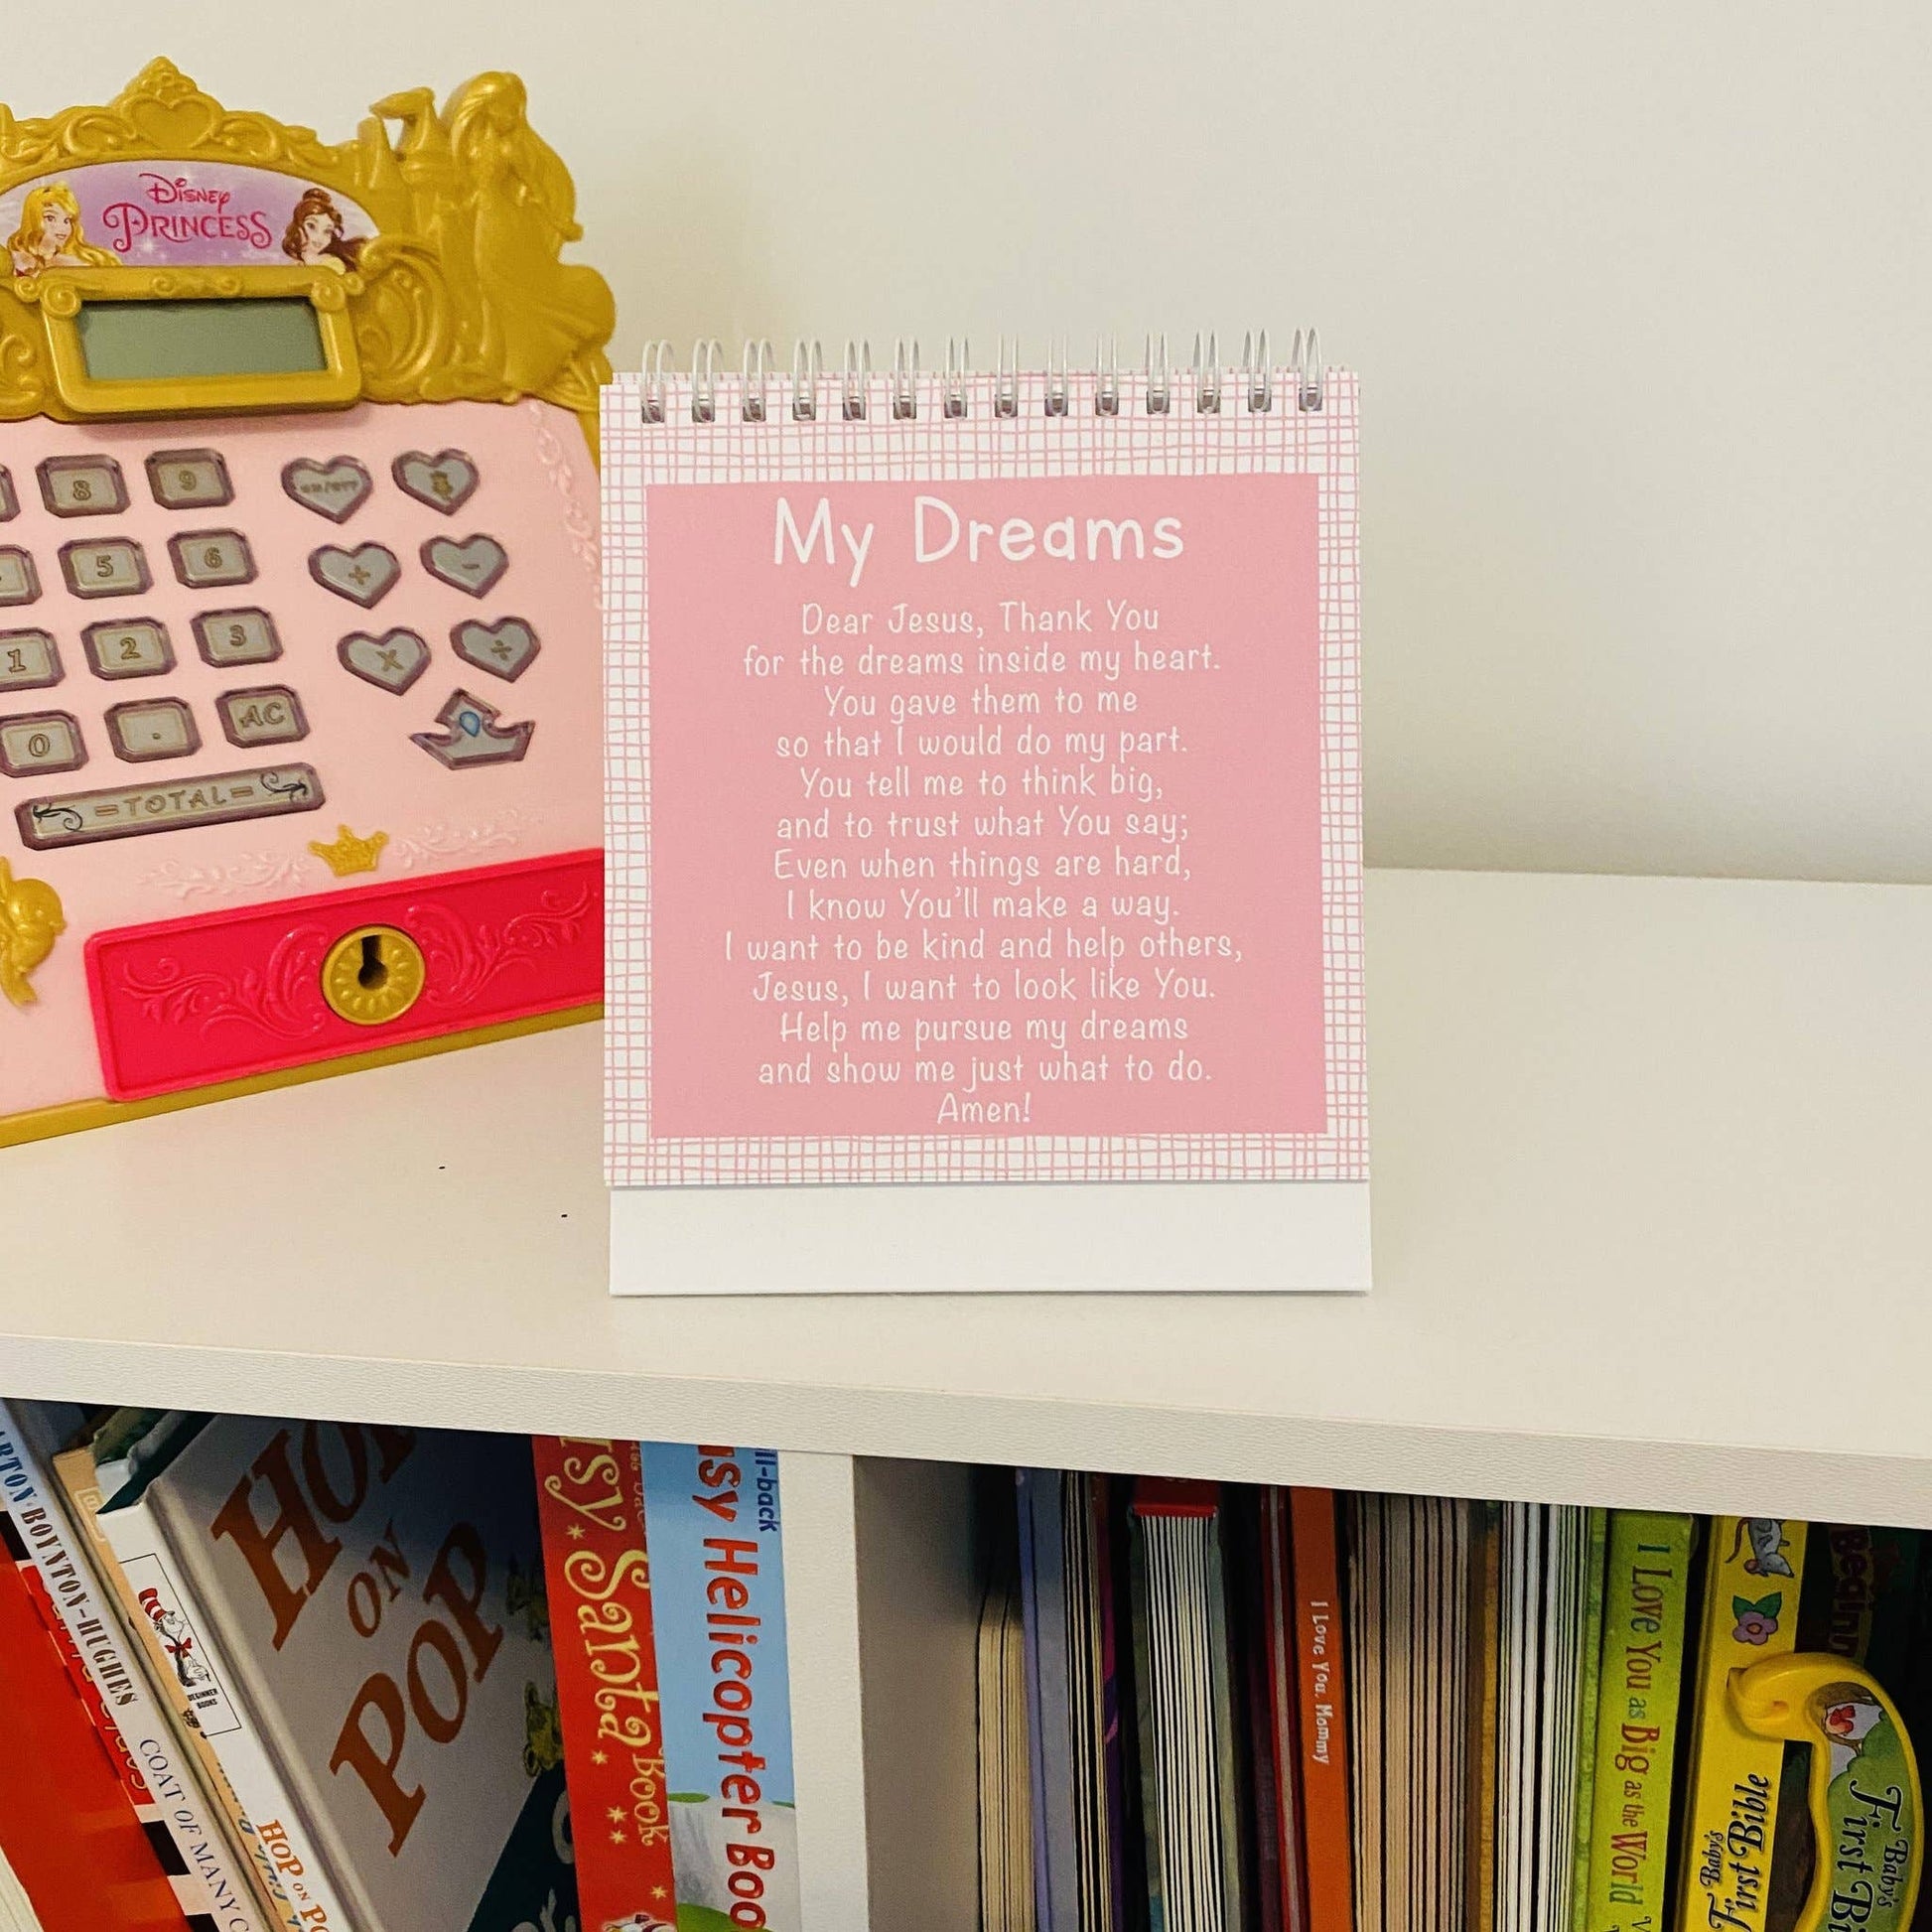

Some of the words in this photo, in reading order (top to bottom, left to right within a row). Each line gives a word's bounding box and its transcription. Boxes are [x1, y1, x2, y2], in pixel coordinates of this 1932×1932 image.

[102, 201, 273, 253] PRINCESS
[71, 479, 92, 501] 8
[179, 470, 196, 492] 9
[94, 554, 114, 578] 5
[204, 547, 223, 570] 6
[773, 496, 875, 589] My
[914, 495, 1184, 564] Dreams
[802, 603, 874, 635] Dear
[888, 603, 984, 639] Jesus,
[998, 599, 1093, 633] Thank
[1106, 599, 1159, 631] You
[7, 647, 27, 673] 1
[119, 635, 142, 660] 2
[228, 624, 248, 647] 3
[743, 644, 784, 677] for
[799, 643, 844, 676] the
[858, 643, 964, 676] dreams
[978, 640, 1066, 674] inside
[1080, 650, 1121, 682] my
[1134, 639, 1220, 671] heart.
[29, 733, 52, 758] 0
[238, 701, 287, 729] AC
[824, 685, 876, 718] You
[890, 694, 957, 726] gave
[970, 683, 1040, 715] them
[1054, 686, 1083, 714] to
[1097, 690, 1138, 713] me
[775, 736, 809, 759] so
[823, 726, 882, 758] that
[897, 725, 903, 756] I
[918, 723, 1002, 757] would
[1017, 723, 1051, 756] do
[1065, 732, 1105, 763] my
[1120, 726, 1187, 764] part.
[799, 766, 852, 799] You
[866, 764, 909, 797] tell
[923, 774, 964, 796] me
[978, 769, 1007, 796] to
[1021, 762, 1097, 796] think
[1110, 762, 1163, 803] big,
[776, 807, 830, 840] and
[844, 811, 874, 839] to
[887, 810, 960, 838] trust
[974, 805, 1044, 837] what
[1058, 804, 1111, 837] You
[1125, 813, 1188, 844] say;
[774, 848, 847, 880] Even
[861, 847, 935, 879] when
[948, 846, 1040, 887] things
[1054, 855, 1101, 878] are
[1115, 843, 1190, 882] hard,
[787, 889, 794, 920] I
[809, 888, 886, 921] know
[993, 886, 1067, 919] make
[1081, 896, 1097, 918] a
[1111, 895, 1179, 926] way.
[726, 930, 732, 961] I
[747, 934, 819, 962] want
[833, 933, 862, 961] to
[877, 929, 908, 961] be
[922, 927, 985, 962] kind
[999, 926, 1052, 960] and
[1066, 925, 1126, 968] help
[1140, 925, 1242, 963] others,
[753, 971, 849, 1008] Jesus,
[864, 970, 871, 1001] I
[886, 973, 957, 1002] want
[972, 973, 1001, 1001] to
[1015, 967, 1077, 1001] look
[1090, 967, 1141, 1001] like
[1154, 966, 1215, 1000] You.
[779, 1010, 847, 1053] Help
[861, 1020, 901, 1042] me
[915, 1018, 1013, 1052] pursue
[1026, 1019, 1066, 1050] my
[1080, 1008, 1188, 1041] dreams
[758, 1051, 811, 1085] and
[826, 1051, 901, 1084] show
[915, 1060, 955, 1083] me
[962, 1055, 1025, 1094] just
[1038, 1049, 1109, 1082] what
[1124, 1053, 1155, 1081] to
[1168, 1048, 1212, 1081] do.
[936, 1091, 1032, 1125] Amen!
[0, 1431, 38, 1503] RTON
[544, 1437, 626, 1532] sy
[755, 1448, 780, 1532] ll-back
[1637, 1543, 1671, 1555] I
[348, 1517, 411, 1638] ON
[1630, 1565, 1674, 1634] Love
[564, 1549, 660, 1748] Santa
[1311, 1614, 1329, 1656] Love
[329, 1522, 504, 1858] POP
[703, 1537, 767, 1835] Helicopter
[1625, 1640, 1663, 1691] You
[1628, 1696, 1647, 1720] as
[1312, 1703, 1334, 1765] Mommy
[1614, 1723, 1661, 1775] Big
[1623, 1780, 1642, 1799] as
[139, 1738, 187, 1803] COAT
[174, 1809, 203, 1836] OF
[190, 1841, 241, 1911] MANY
[1621, 1803, 1645, 1828] the
[1725, 1772, 1771, 1858] Bible
[1836, 1779, 1903, 1874] First
[255, 1818, 305, 1878] HOP
[292, 1881, 311, 1902] ON
[1608, 1831, 1648, 1905] World
[726, 1843, 776, 1932] Boo
[1706, 1864, 1761, 1932] First
